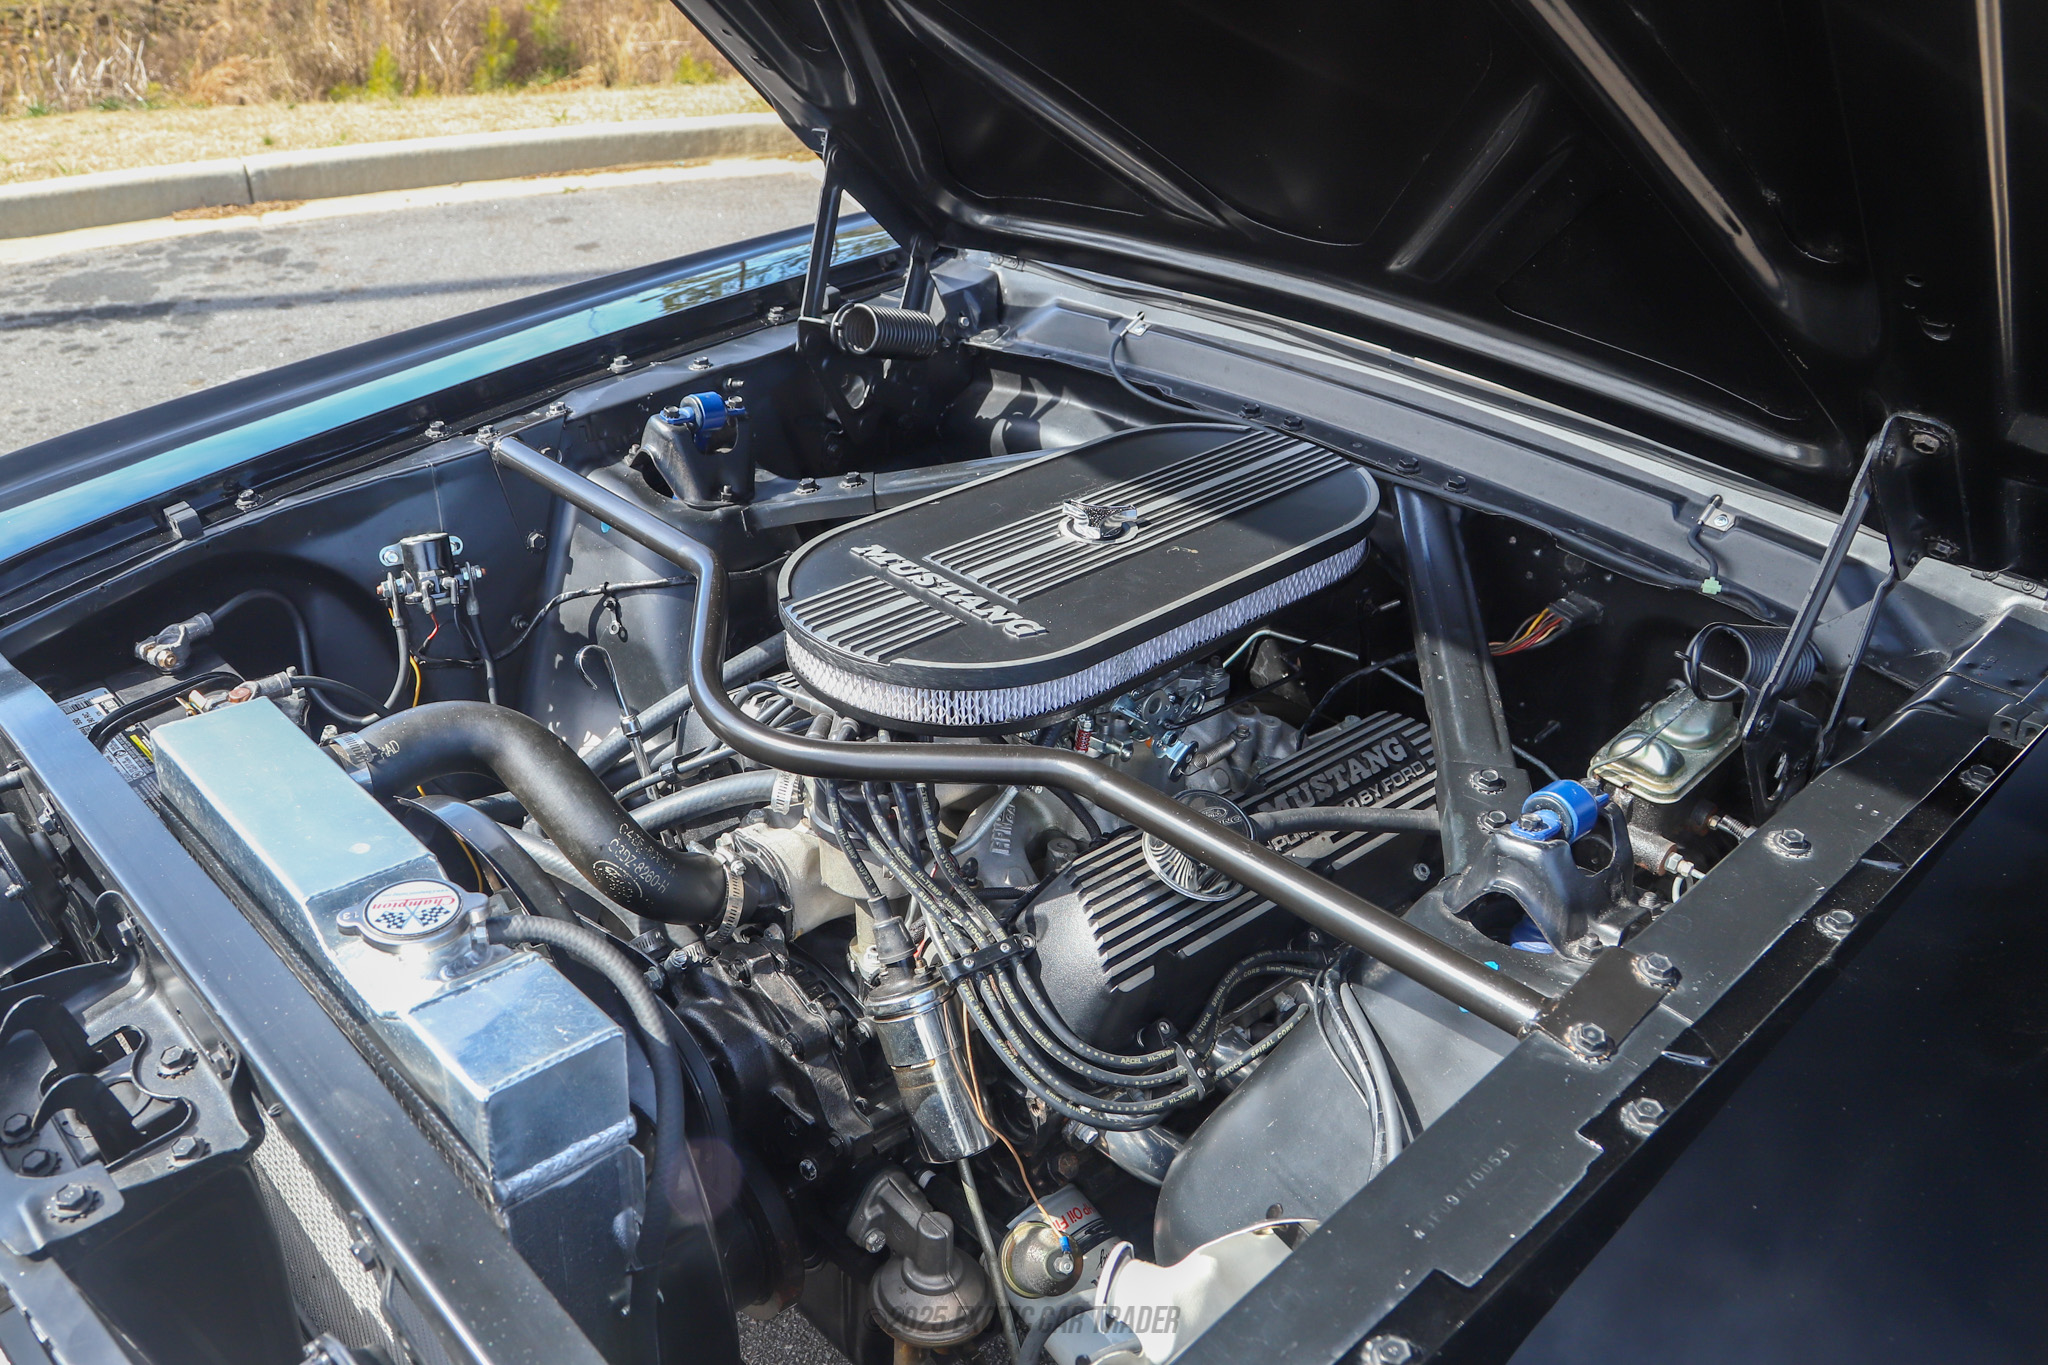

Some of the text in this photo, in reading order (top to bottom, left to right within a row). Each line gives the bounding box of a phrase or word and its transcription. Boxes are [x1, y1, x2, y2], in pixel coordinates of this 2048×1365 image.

[850, 544, 1049, 638] MUSTANG
[1257, 737, 1408, 812] MUSTANG
[1357, 783, 1380, 806] BY
[1382, 760, 1426, 793] FORD
[837, 828, 858, 860] HI-TEMP
[856, 862, 874, 886] SUPER
[372, 896, 456, 911] Champion
[867, 837, 963, 941] ACCEL HI-TEMP SUPER STOCK
[893, 846, 985, 943] ACCEL HI-TEMP SUPER STOCK
[960, 981, 975, 1003] UPER
[973, 1005, 993, 1031] STOCK
[996, 1038, 1018, 1064] SPIRAL
[981, 979, 997, 1002] CORE
[1009, 1029, 1026, 1050] WIRE
[1001, 981, 1018, 1005] CORE
[1034, 1029, 1053, 1049] WIRE
[1196, 1012, 1212, 1034] STOCK
[1120, 1048, 1175, 1065] ACCEL HI-TEMP
[1220, 1060, 1244, 1078] STOCK
[1251, 1039, 1275, 1059] SPIRAL
[1066, 1207, 1083, 1224] Oil
